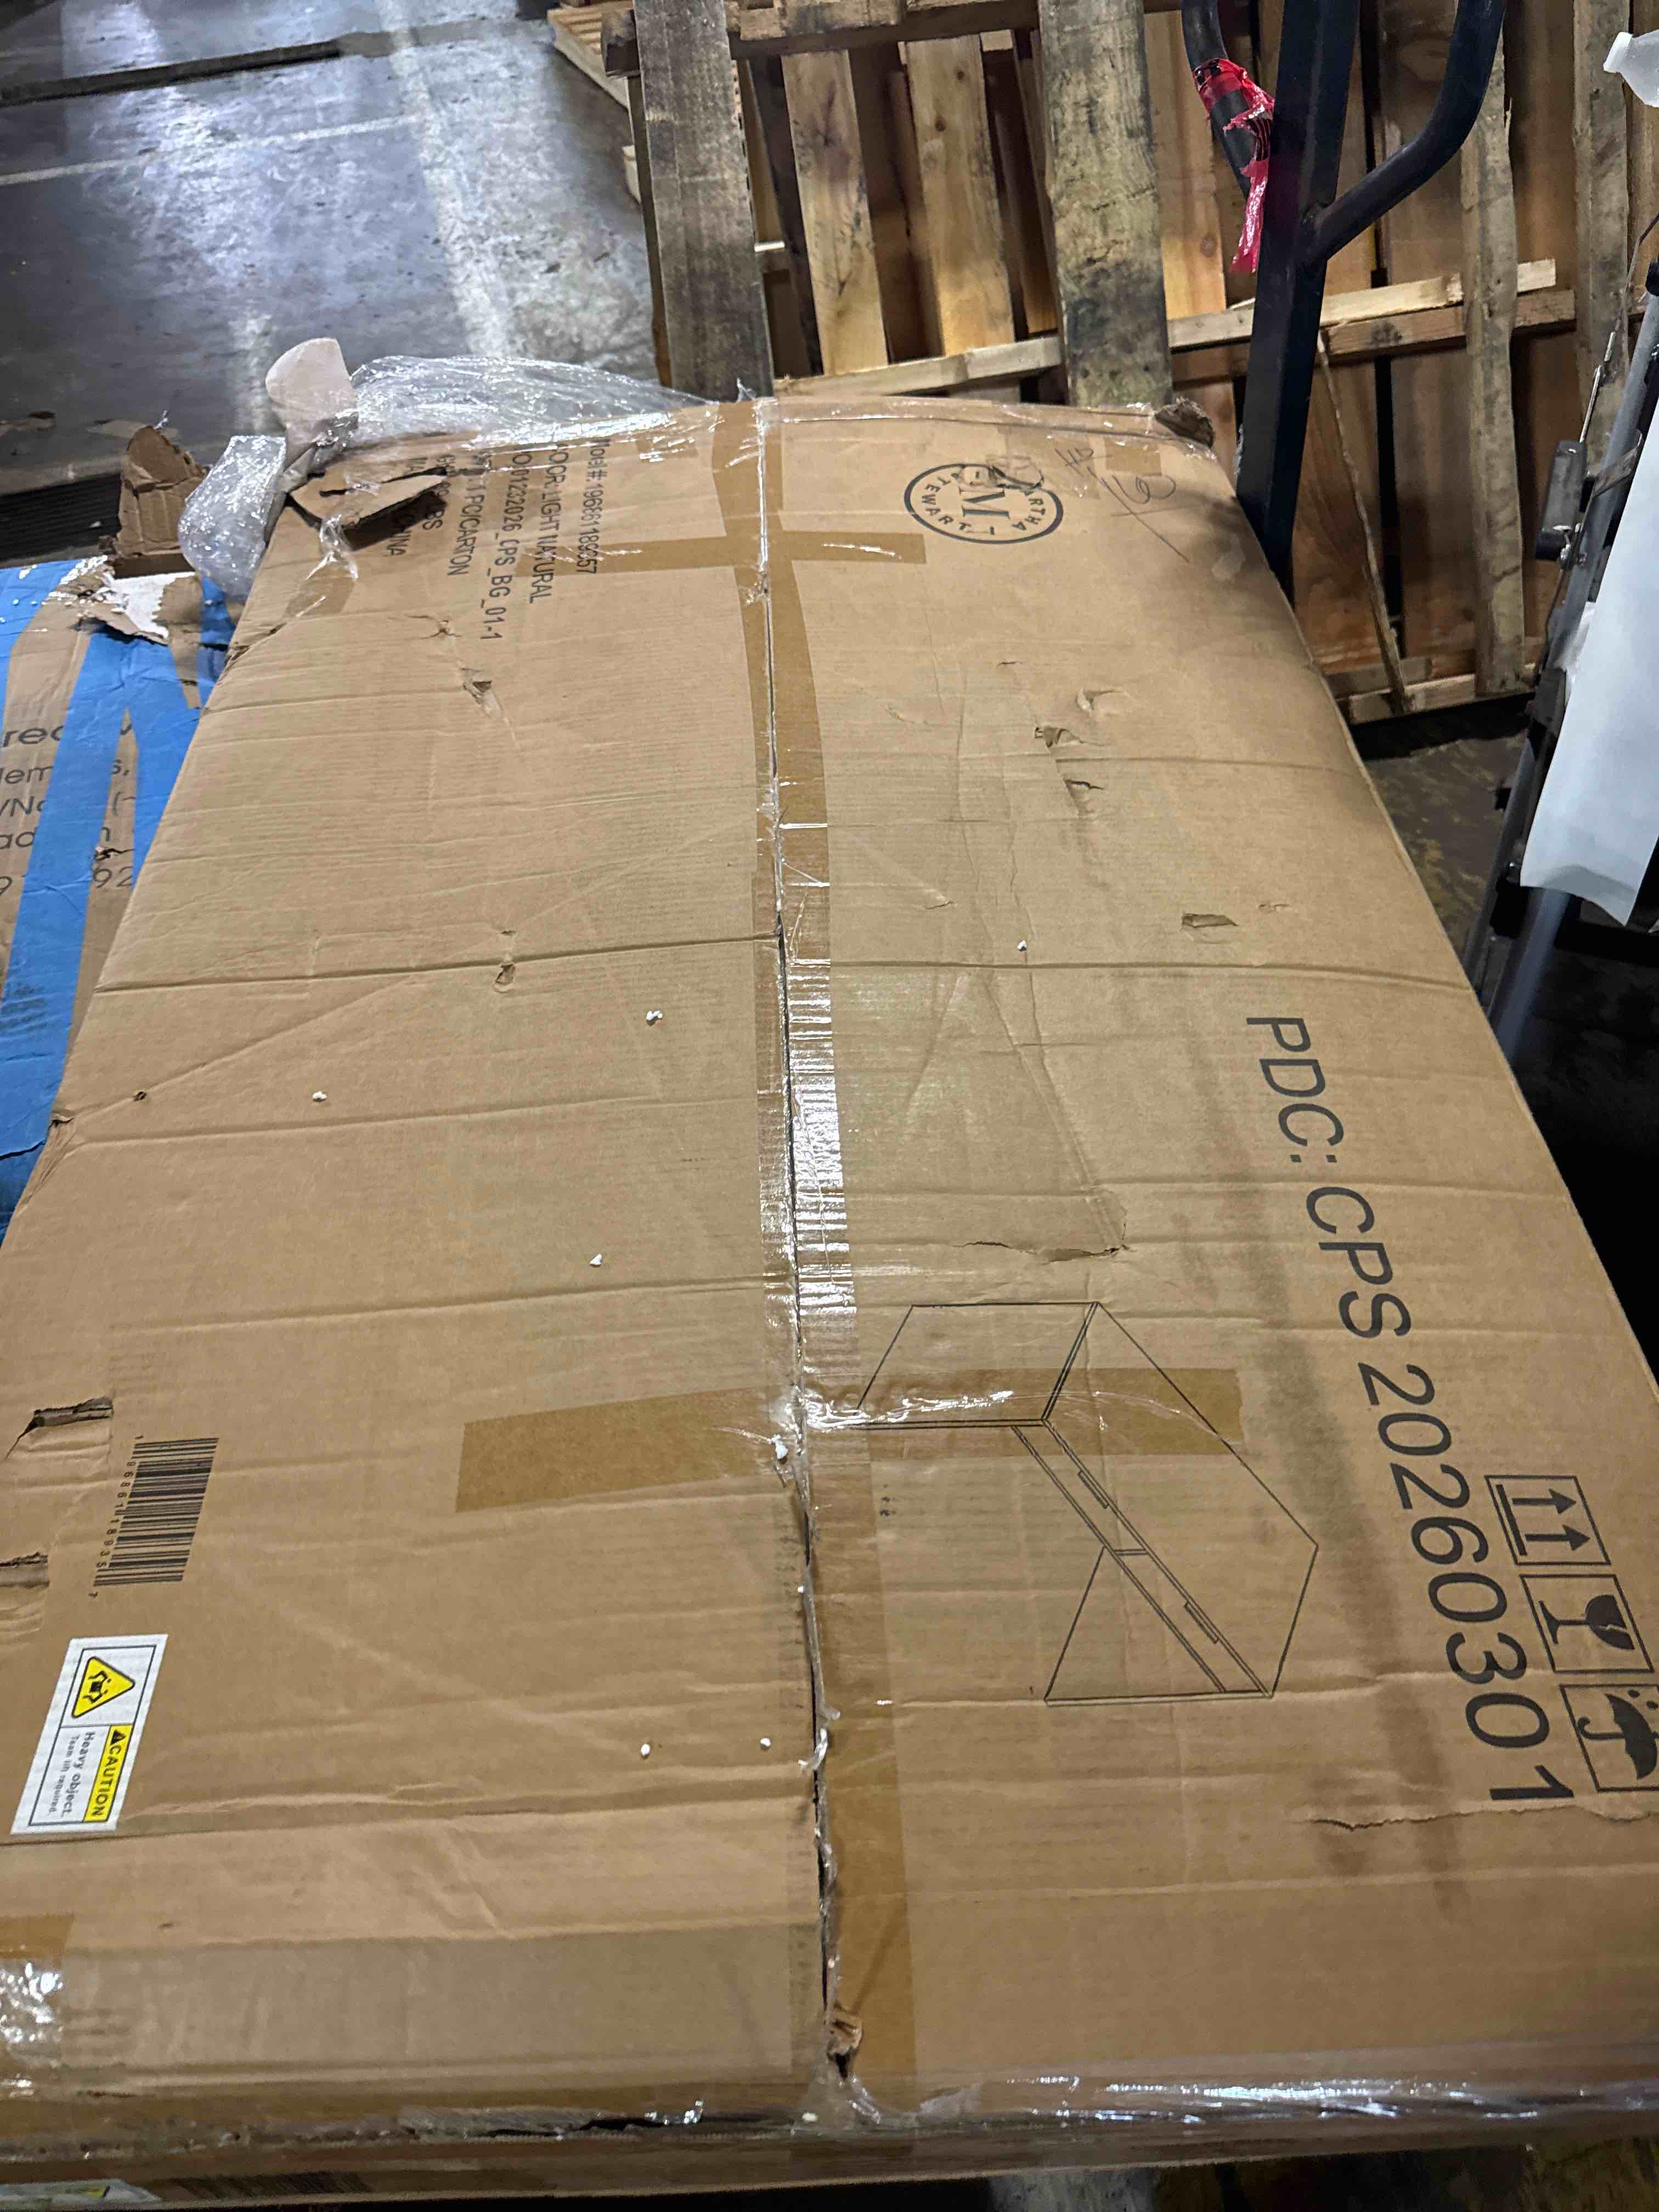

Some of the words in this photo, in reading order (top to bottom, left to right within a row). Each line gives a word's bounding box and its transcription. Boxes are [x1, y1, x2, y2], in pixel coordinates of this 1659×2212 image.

[539, 491, 563, 531] LIGHT
[959, 486, 1010, 519] M
[1011, 488, 1045, 531] ARTHA
[1246, 1017, 1344, 1164] PDC:
[1305, 1186, 1412, 1340] CPS
[1358, 1363, 1574, 1801] 20260301
[61, 1760, 72, 1773] lift
[66, 1734, 80, 1758] Team
[72, 1731, 96, 1769] Heavy
[91, 1745, 122, 1816] CAUTION
